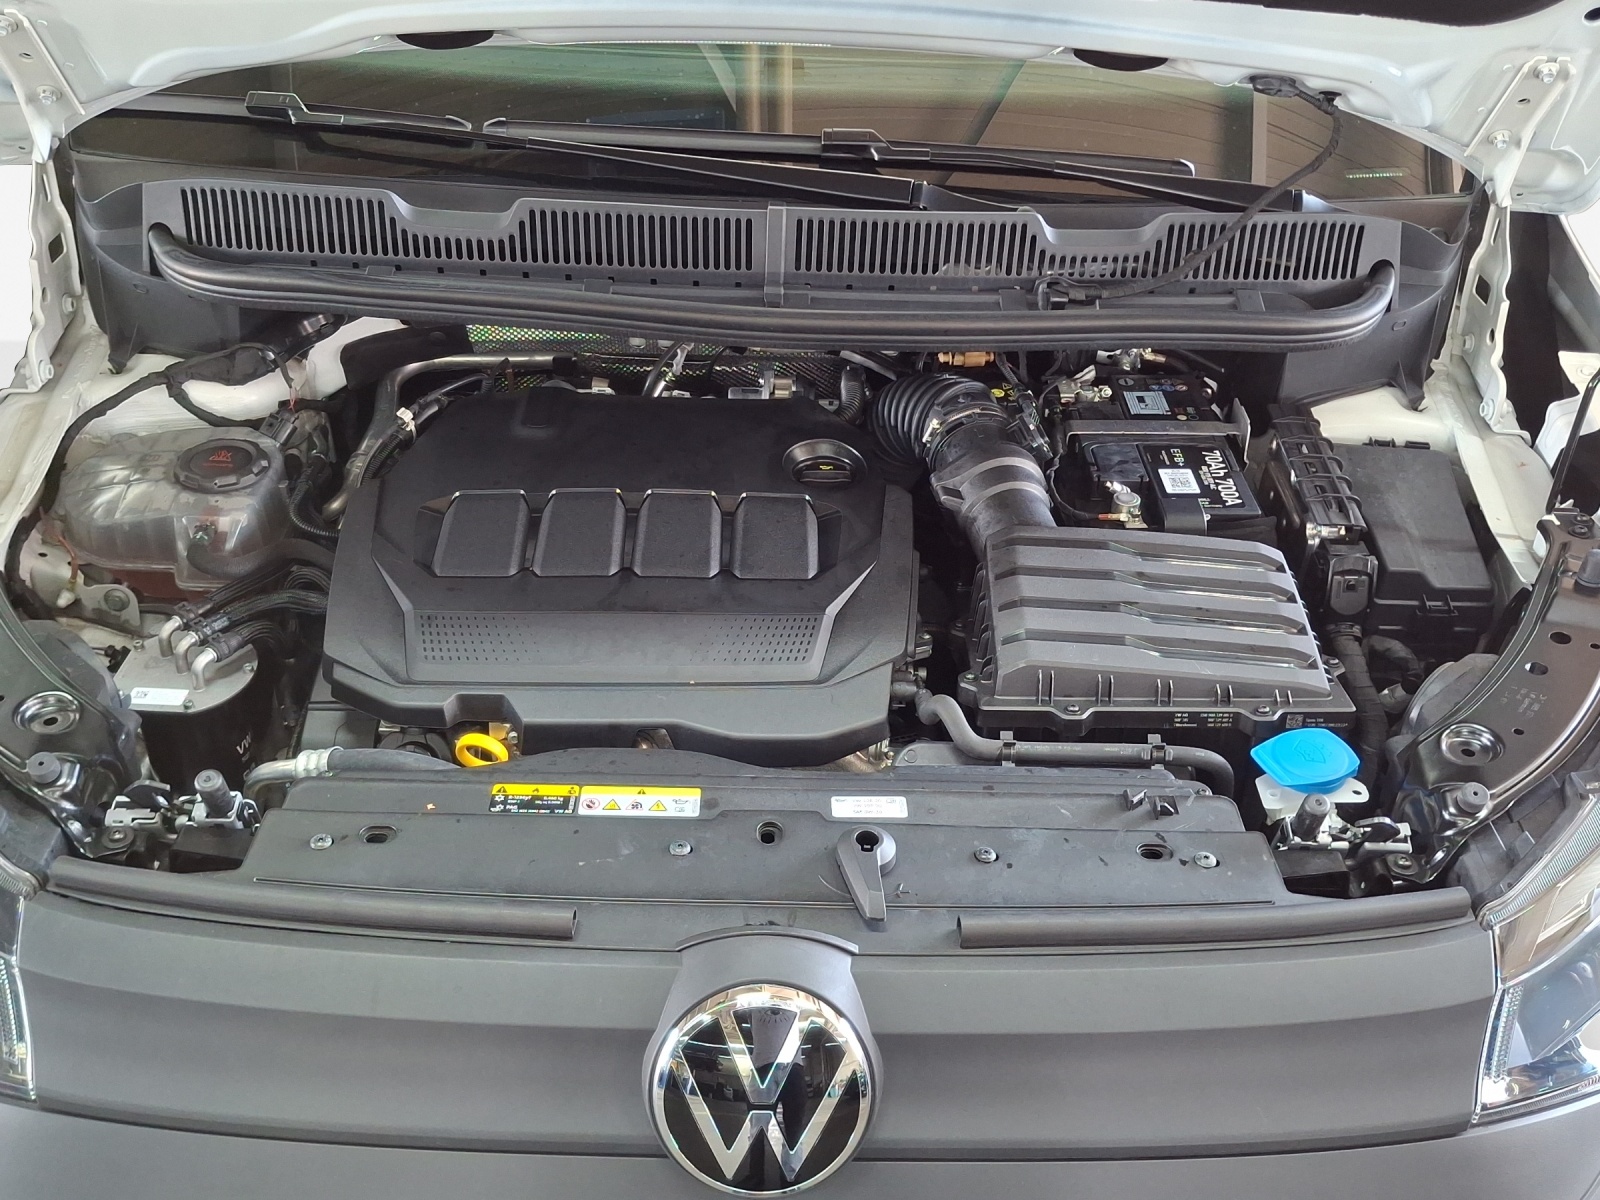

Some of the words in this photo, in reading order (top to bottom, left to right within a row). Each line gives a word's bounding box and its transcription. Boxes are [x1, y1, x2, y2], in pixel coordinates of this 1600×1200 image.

[1170, 448, 1185, 467] EFB+
[1201, 450, 1228, 477] 70Ah
[1214, 478, 1243, 506] 700A
[662, 998, 866, 1186] VW
